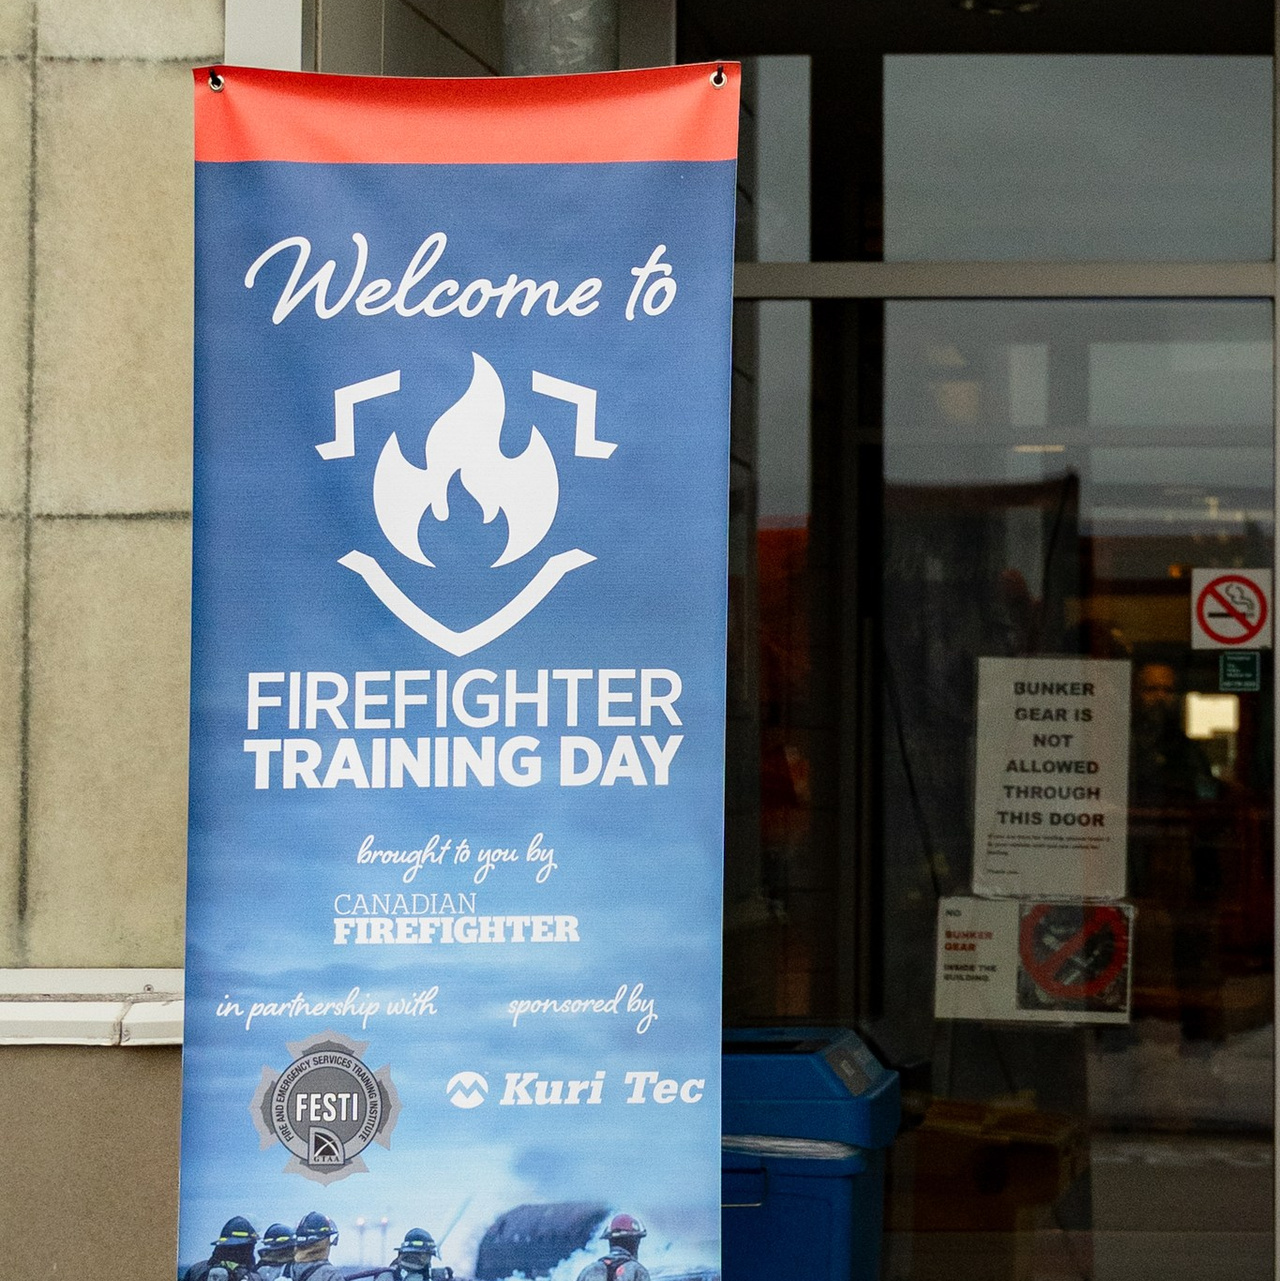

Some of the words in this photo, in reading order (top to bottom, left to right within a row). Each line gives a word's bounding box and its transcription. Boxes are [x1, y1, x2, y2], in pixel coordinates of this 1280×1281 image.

[244, 232, 601, 325] Welcome
[625, 244, 678, 321] to
[247, 668, 684, 730] FIREFIGHTER
[1013, 682, 1095, 696] BUNKER
[1014, 708, 1067, 721] GEAR
[1075, 708, 1093, 722] IS
[1033, 734, 1073, 747] NOT
[244, 736, 542, 790] TRAINING
[560, 734, 684, 787] DAY
[1006, 760, 1099, 774] ALLOWED
[1003, 785, 1100, 800] THROUGH
[997, 811, 1043, 825] THIS
[1050, 813, 1105, 827] DOOR
[356, 834, 452, 884] brought
[453, 838, 471, 864] to
[474, 848, 519, 884] you
[526, 832, 558, 884] by
[334, 893, 477, 915] CANADIAN
[333, 915, 580, 945] FIREFIGHTER
[945, 942, 976, 951] GEAR
[216, 994, 244, 1017] in
[245, 986, 380, 1031] partnership
[386, 985, 439, 1016] with
[508, 984, 627, 1027] sponsored
[627, 982, 658, 1034] by
[313, 1055, 351, 1068] SERVICES
[276, 1059, 311, 1103] EMERGENCY
[352, 1064, 377, 1099] TRAINING
[499, 1071, 606, 1106] Kuri
[624, 1071, 705, 1104] Tec
[275, 1105, 284, 1123] AND
[296, 1093, 359, 1122] FESTI
[359, 1100, 378, 1142] INSTITUTE
[279, 1123, 295, 1142] FIRE
